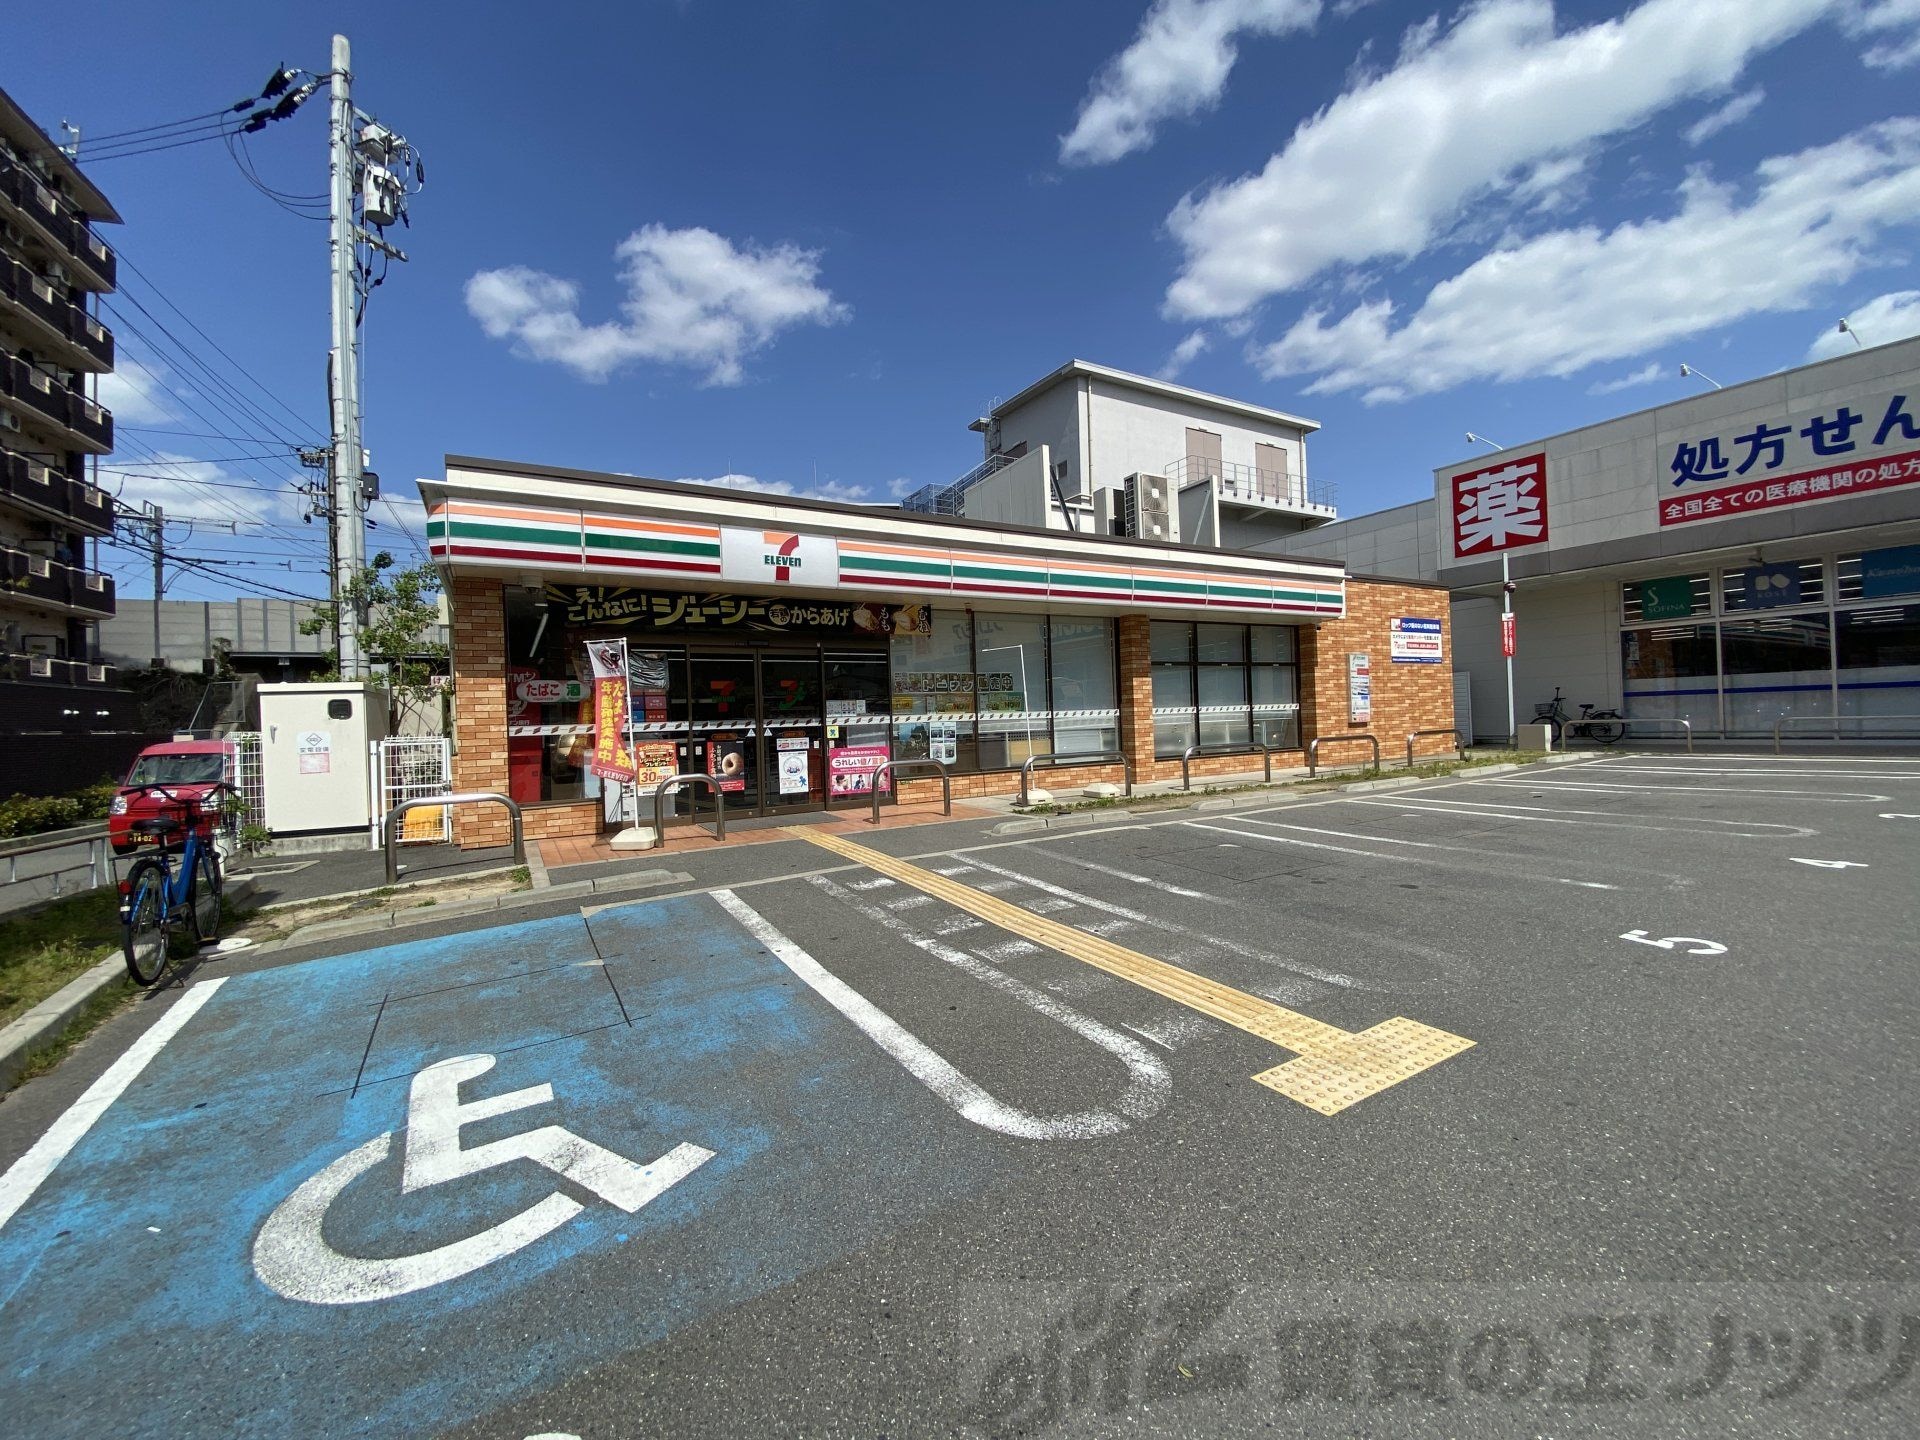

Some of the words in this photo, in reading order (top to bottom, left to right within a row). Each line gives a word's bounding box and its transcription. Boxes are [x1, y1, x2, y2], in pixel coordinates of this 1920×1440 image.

[1670, 395, 1920, 488] 処方せん
[1457, 463, 1543, 551] 薬
[762, 530, 800, 581] 7
[567, 594, 648, 622] こんなに!
[651, 595, 766, 626] ジューシー
[791, 605, 851, 627] からあげ
[1647, 603, 1686, 614] SOFINA
[526, 683, 560, 697] たばこ
[1789, 856, 1869, 869] 4
[1618, 929, 1729, 955] 5
